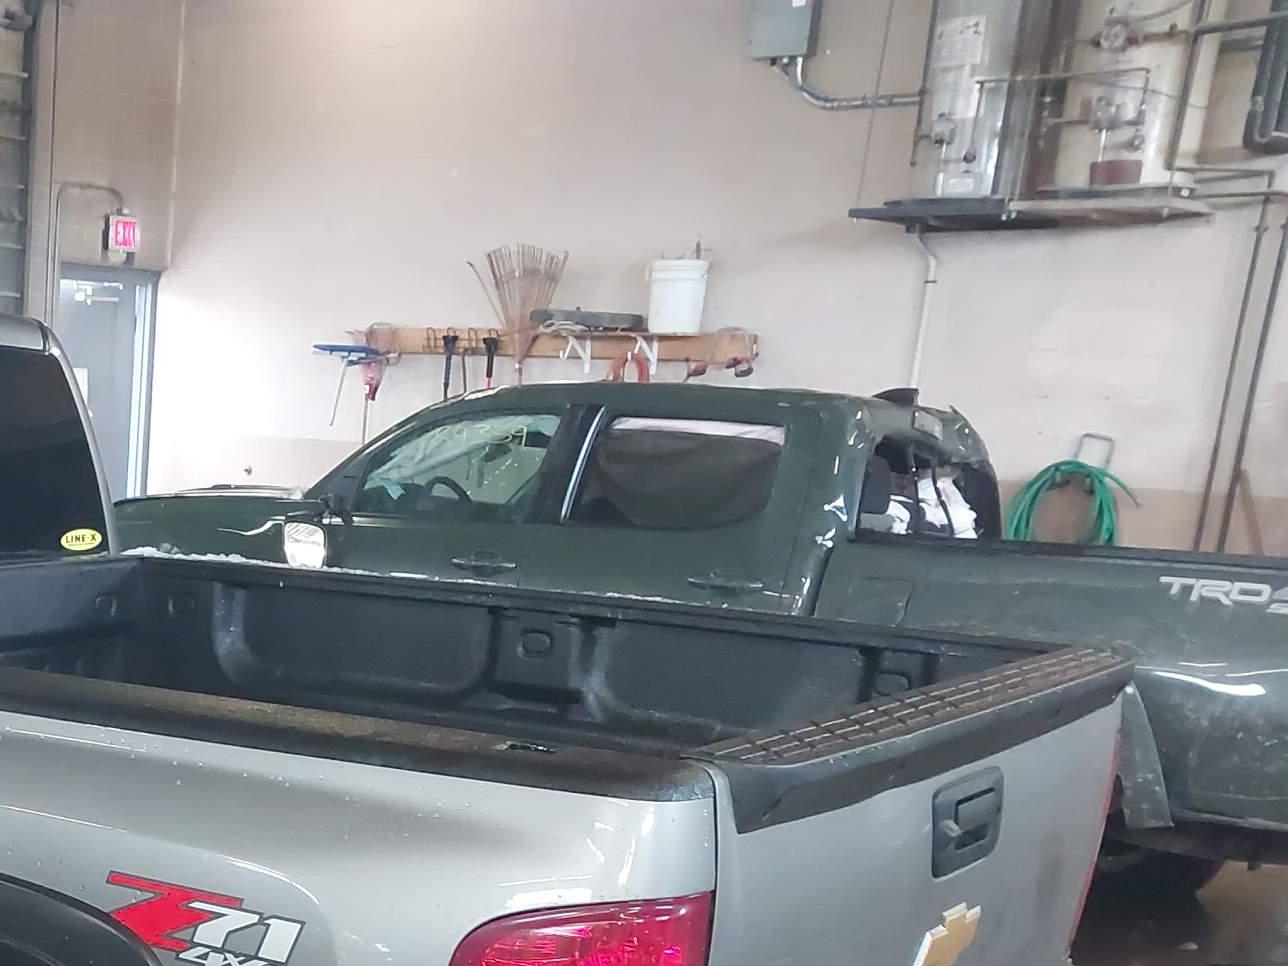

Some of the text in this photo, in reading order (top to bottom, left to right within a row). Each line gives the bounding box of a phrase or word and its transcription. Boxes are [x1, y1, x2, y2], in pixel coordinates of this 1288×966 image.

[65, 533, 97, 544] LINE-X
[1159, 576, 1272, 606] TRD
[106, 870, 306, 965] Z71
